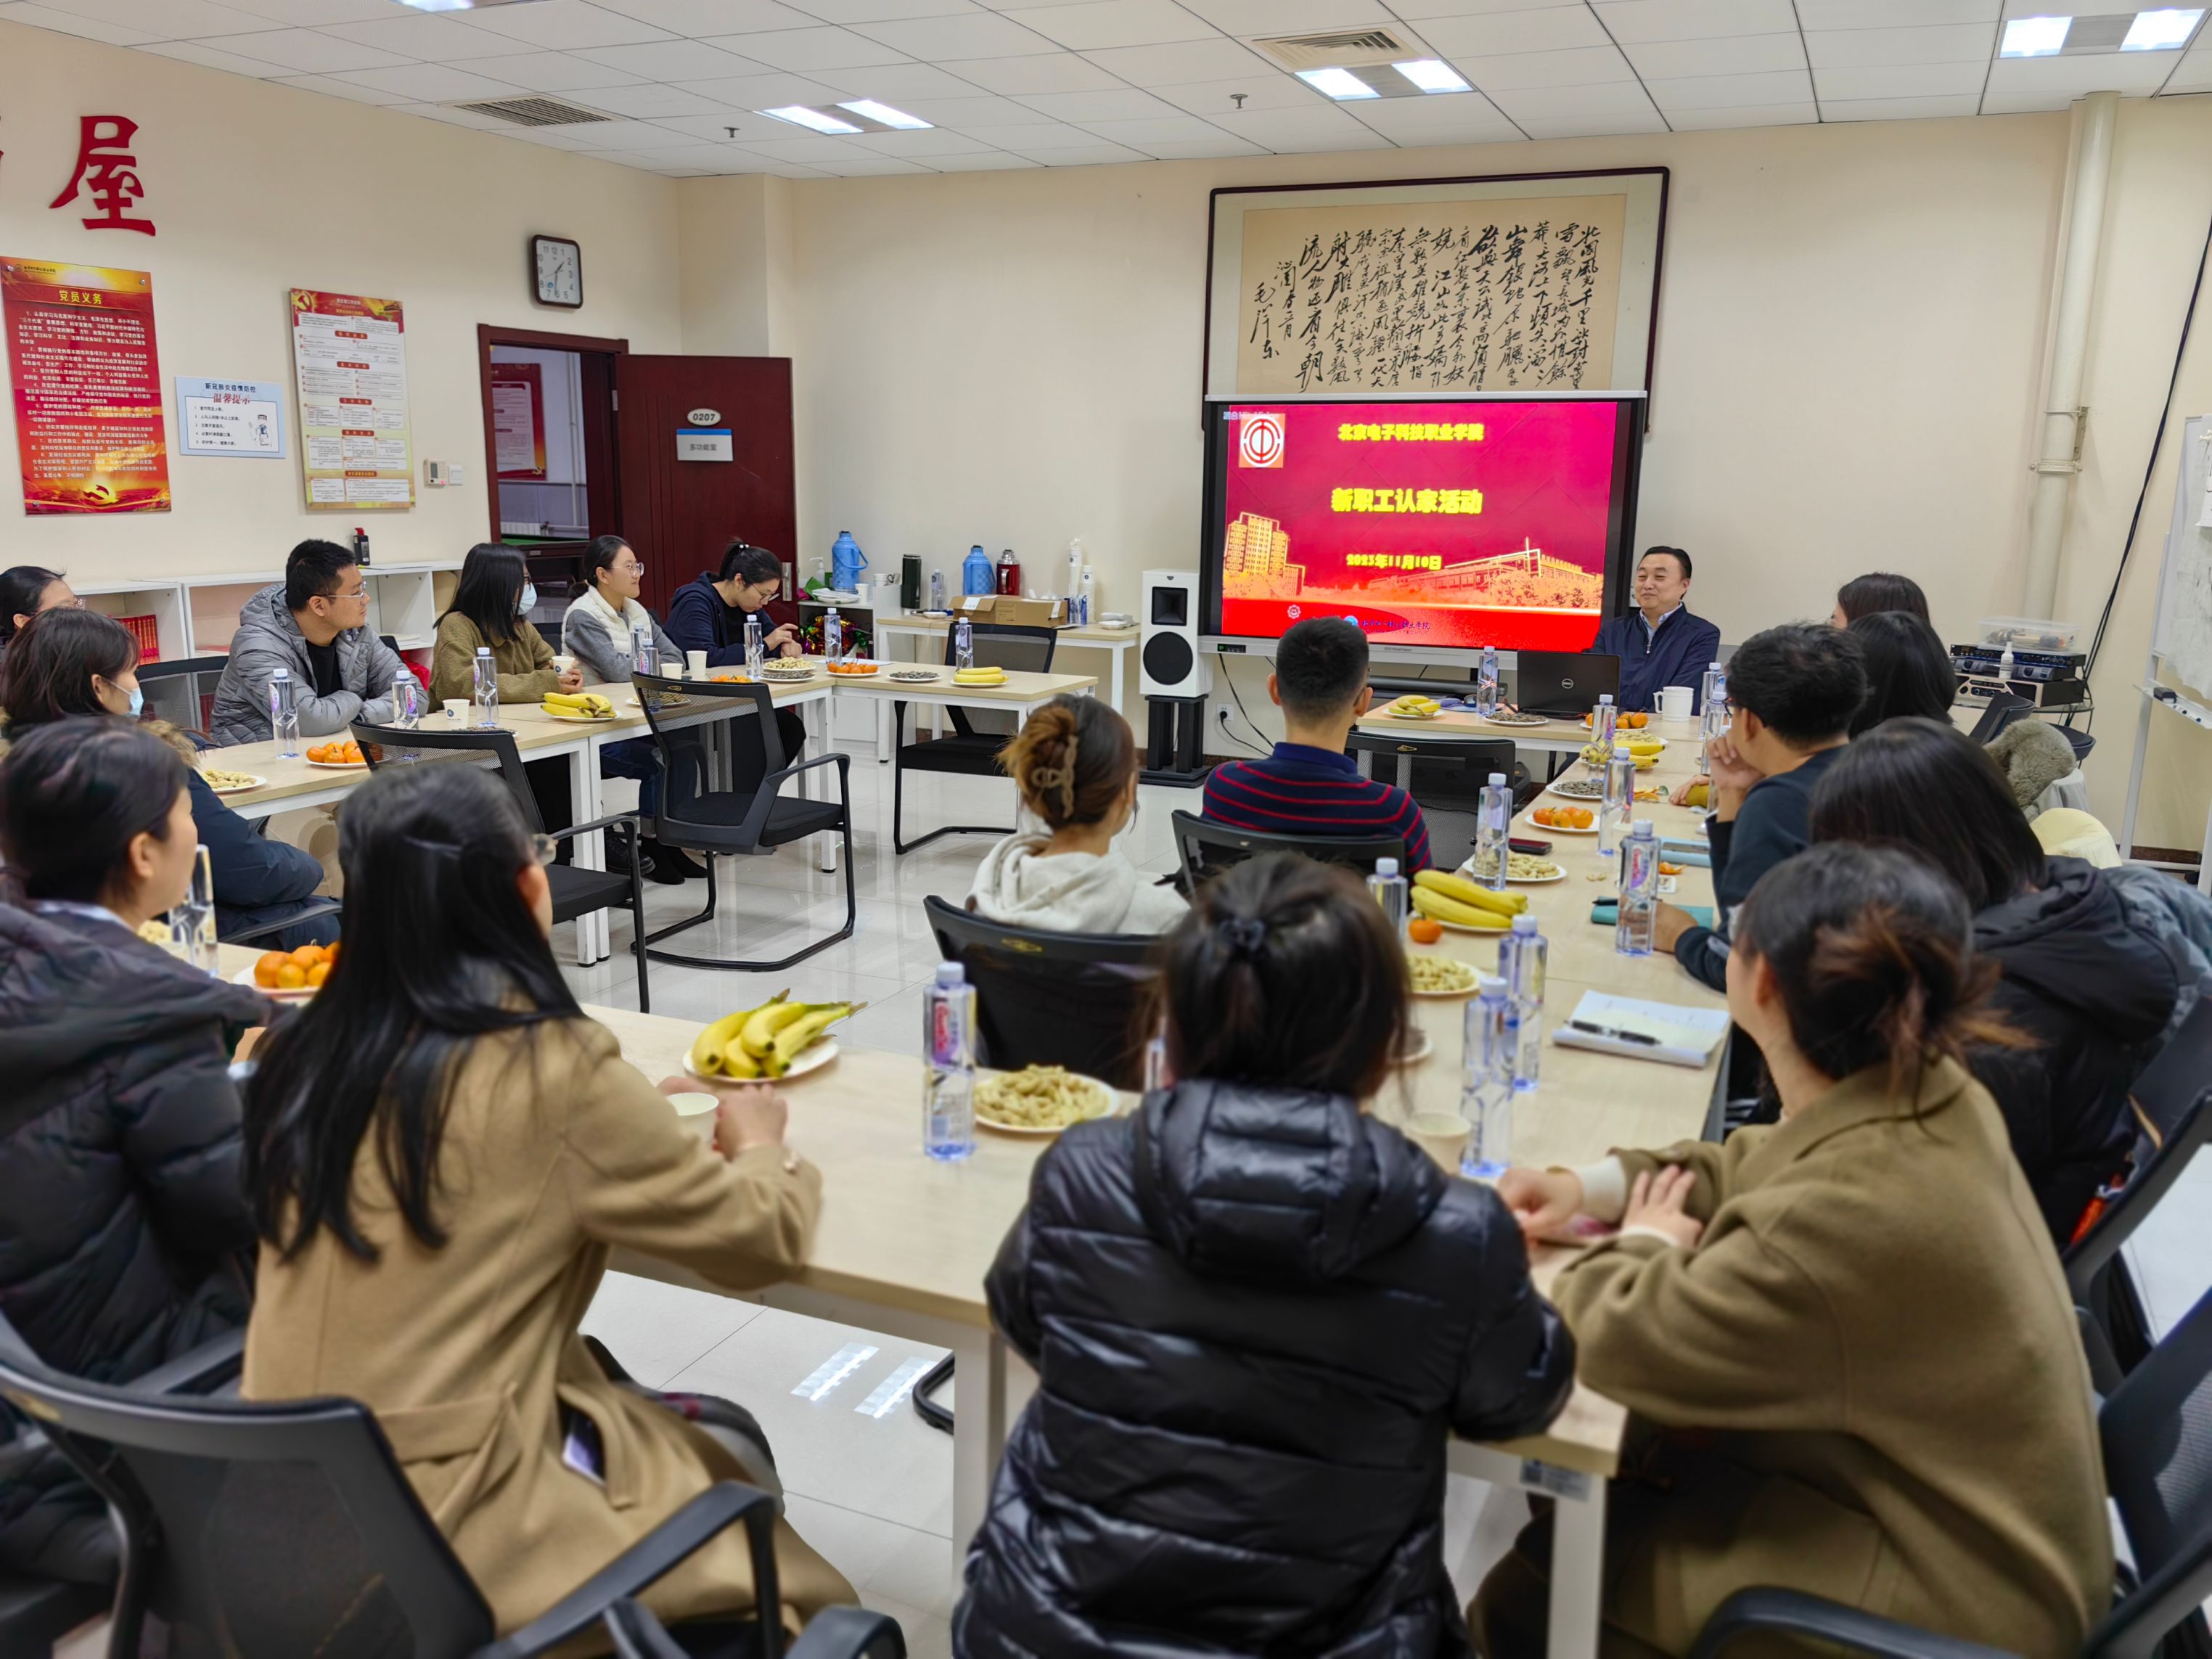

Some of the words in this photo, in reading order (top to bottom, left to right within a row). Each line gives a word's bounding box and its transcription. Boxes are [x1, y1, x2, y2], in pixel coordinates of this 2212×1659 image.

[49, 115, 156, 237] 屋
[59, 289, 103, 306] 党员义务
[205, 382, 256, 393] 新冠肺炎疫情防控
[213, 393, 250, 405] 温馨提示
[1338, 422, 1485, 441] 北京电子科技职业学院
[1331, 487, 1483, 515] 新职工认家活动
[1345, 553, 1443, 571] 2023年11月10日
